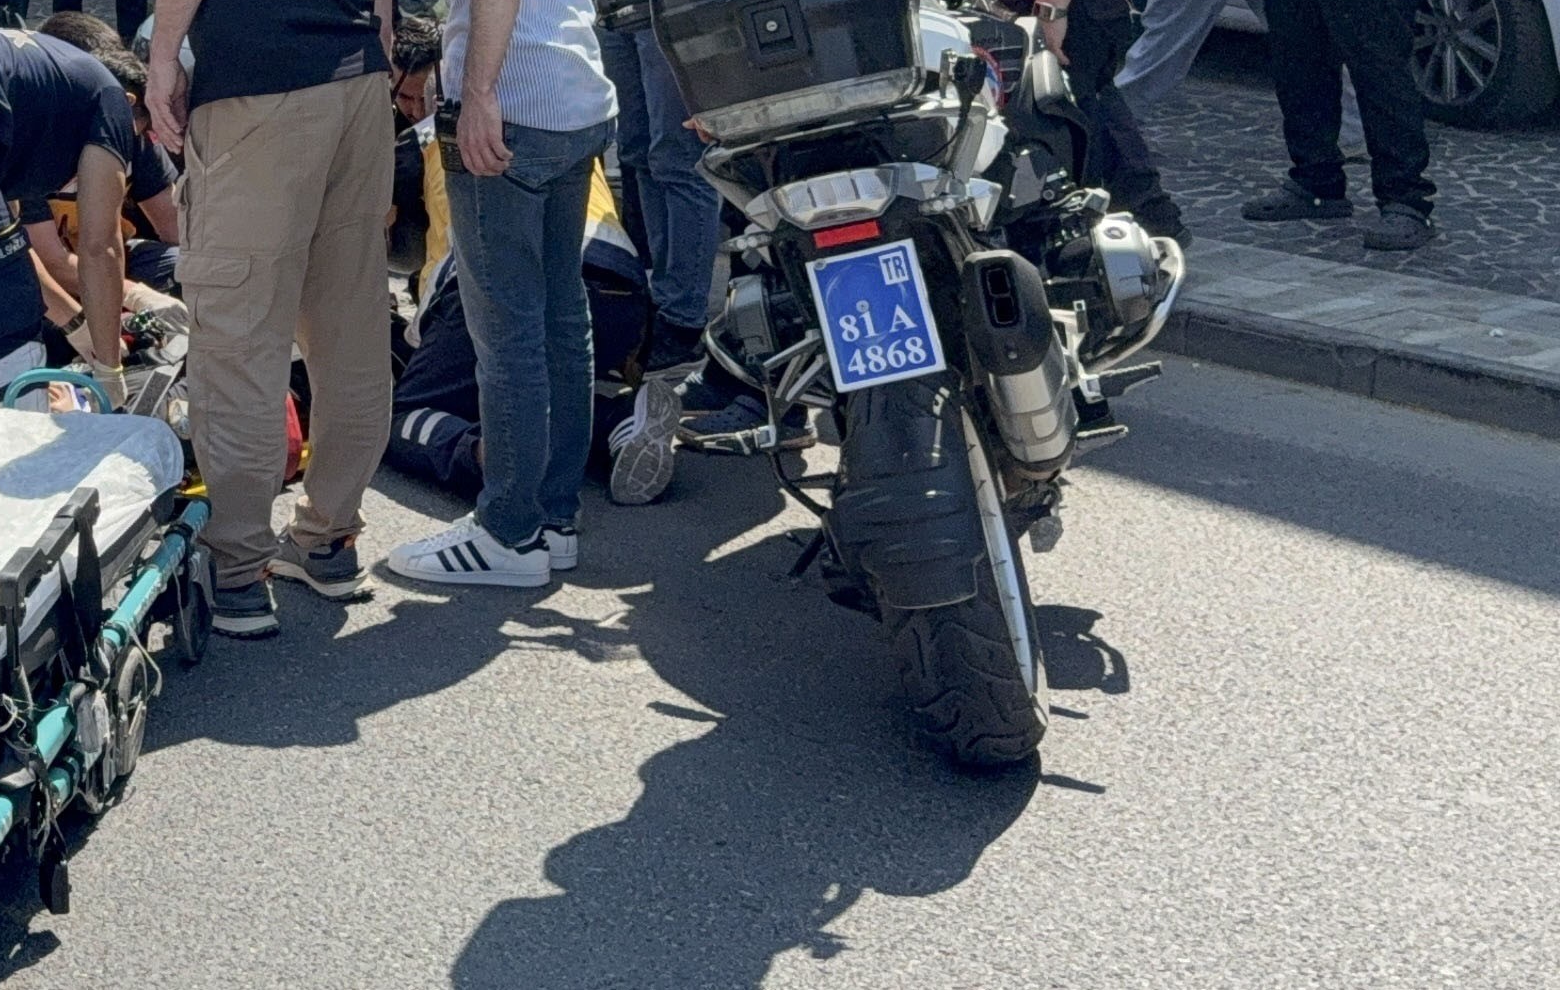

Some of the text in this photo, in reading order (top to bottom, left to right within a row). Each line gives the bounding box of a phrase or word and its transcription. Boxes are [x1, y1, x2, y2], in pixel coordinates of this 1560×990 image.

[882, 255, 906, 281] TR
[839, 303, 918, 342] 81 A
[847, 336, 927, 376] 4868
